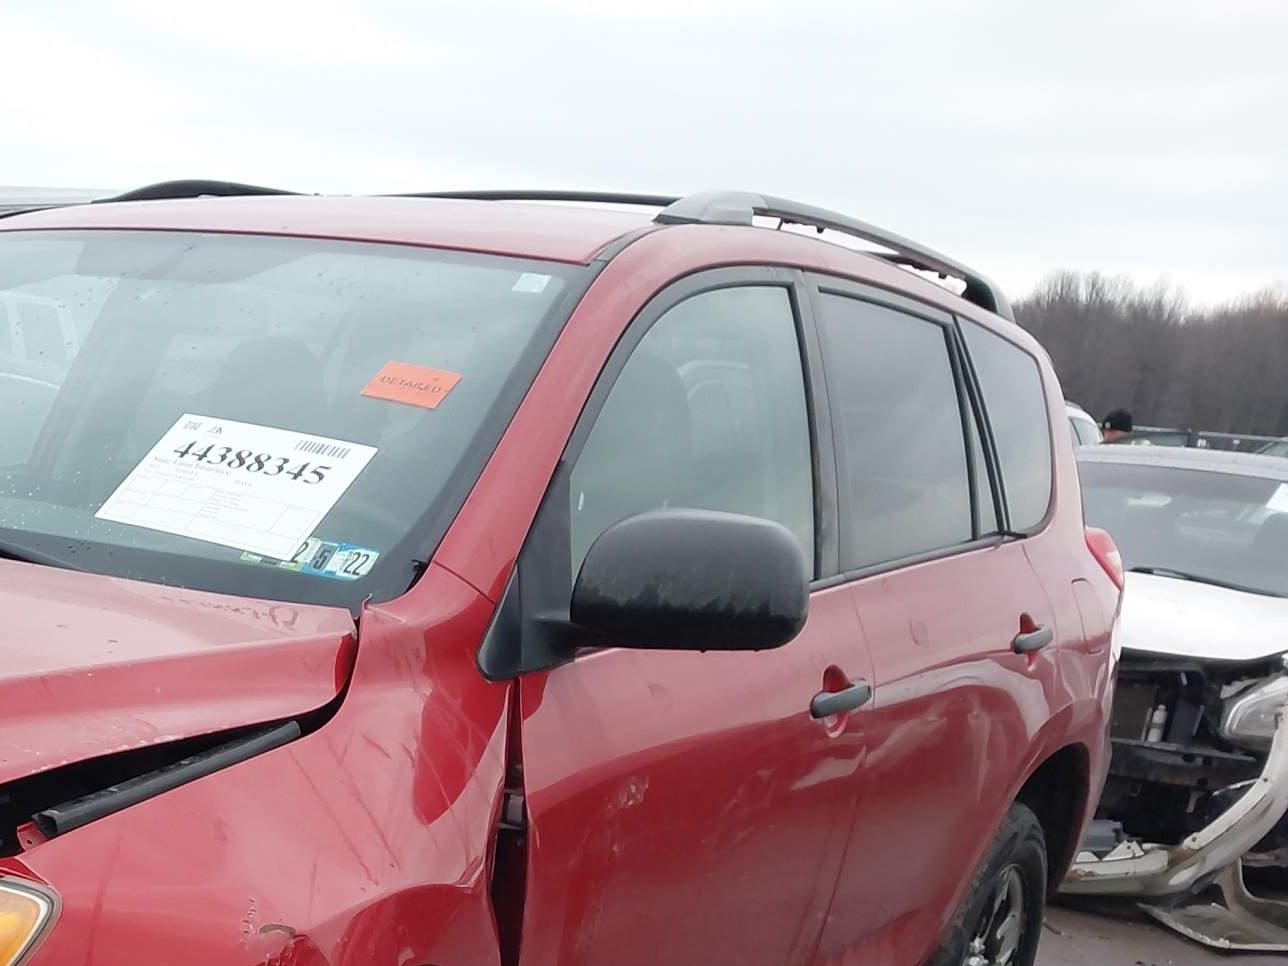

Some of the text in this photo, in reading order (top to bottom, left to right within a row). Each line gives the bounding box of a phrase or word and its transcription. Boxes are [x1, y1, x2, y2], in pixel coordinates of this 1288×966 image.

[380, 376, 442, 393] DETAILED
[173, 440, 332, 485] 44388345
[343, 551, 370, 576] 22
